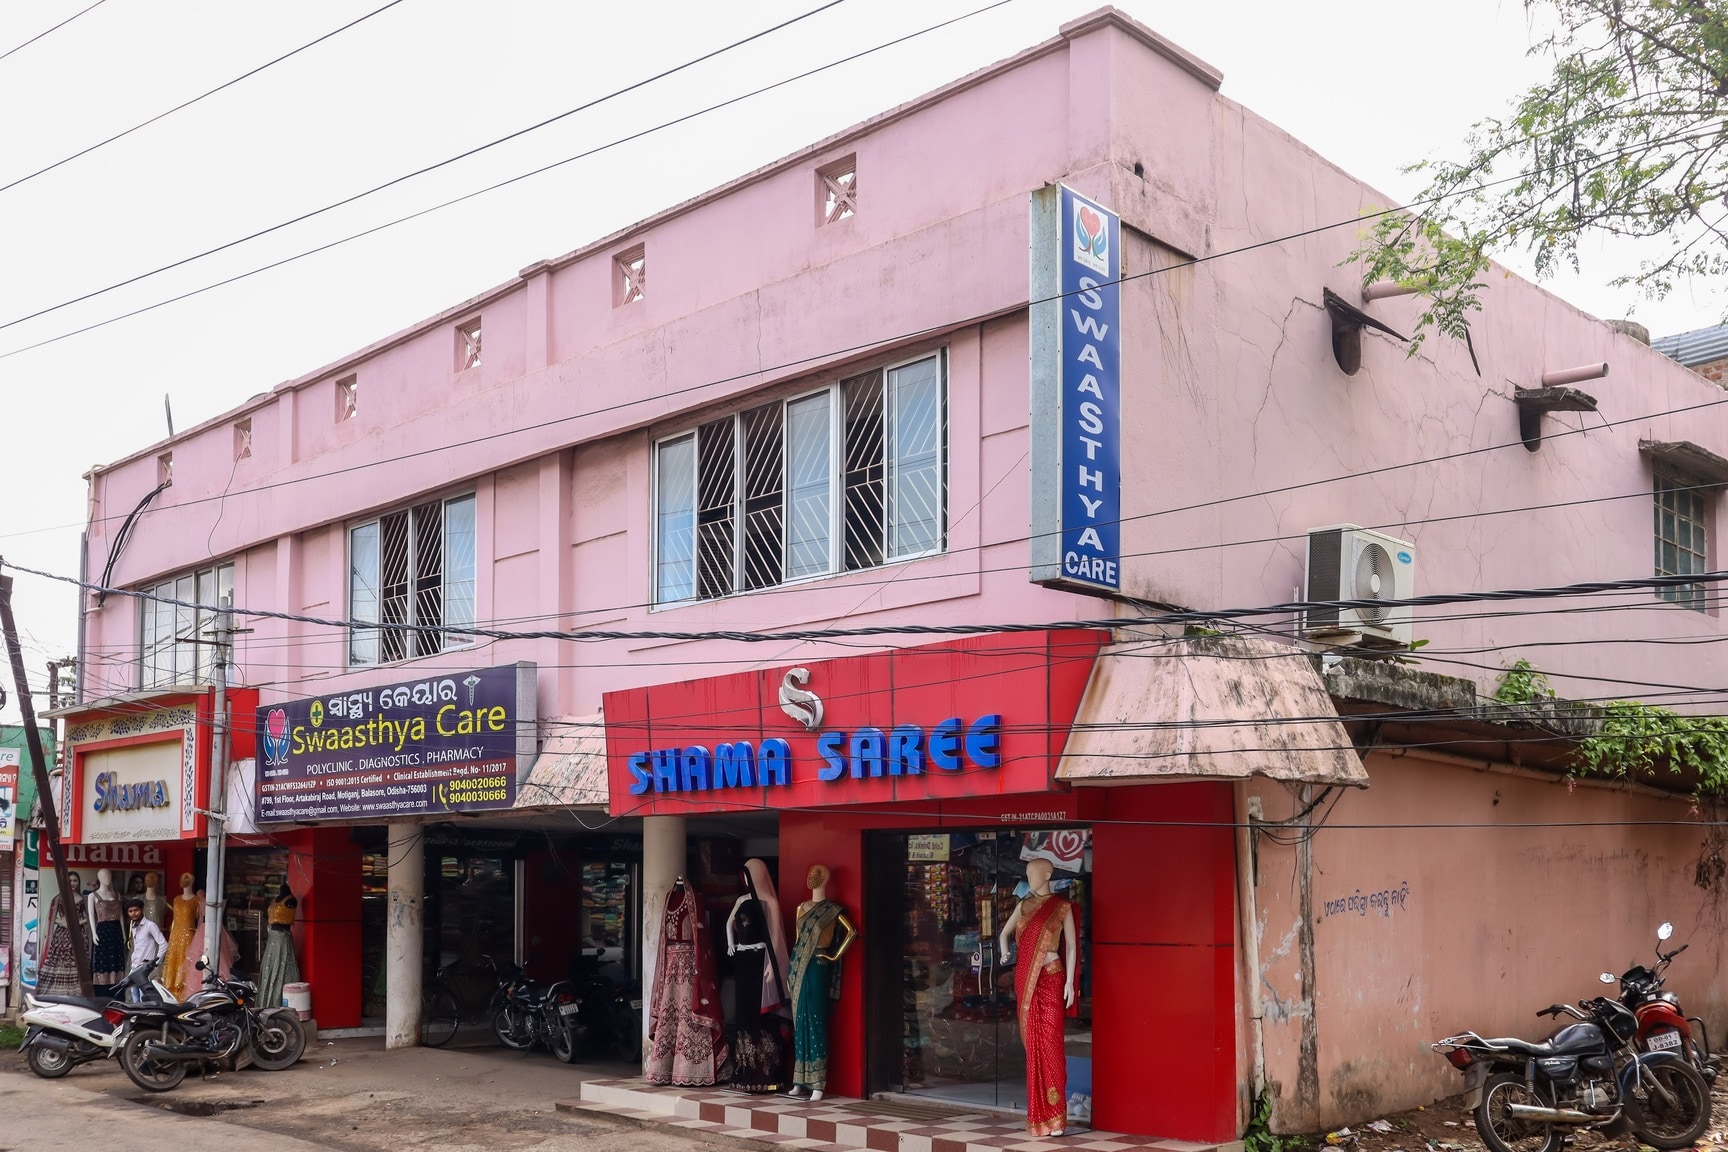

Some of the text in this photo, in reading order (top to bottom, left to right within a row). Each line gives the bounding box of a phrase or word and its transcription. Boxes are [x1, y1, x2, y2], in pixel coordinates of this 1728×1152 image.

[1070, 276, 1109, 552] SWAASTHYA
[1065, 550, 1117, 584] CARE
[292, 704, 506, 754] Swaasthya Care
[306, 760, 354, 775] POLYCLINIC
[359, 753, 420, 770] DIAGNOSTICS
[427, 746, 484, 763] PHARMACY
[627, 714, 1001, 795] SHAMA SAREE
[326, 778, 334, 787] ISO
[335, 776, 360, 786] 9001:2015
[360, 773, 383, 784] Certified
[393, 770, 413, 781] Clinical
[413, 767, 452, 779] Establishment
[482, 763, 506, 773] 11/2017
[449, 776, 507, 791] 9040020666
[93, 771, 170, 813] Shama
[274, 795, 282, 804] 1st
[282, 794, 295, 804] Floor,
[322, 791, 337, 801] Road,
[337, 788, 361, 801] Motiganj,
[361, 787, 386, 797] Balasore,
[386, 784, 427, 796] Odisha-756003
[340, 802, 362, 813] Website:
[362, 799, 428, 811] www.swaasthyacare.com
[449, 789, 507, 804] 9040030666
